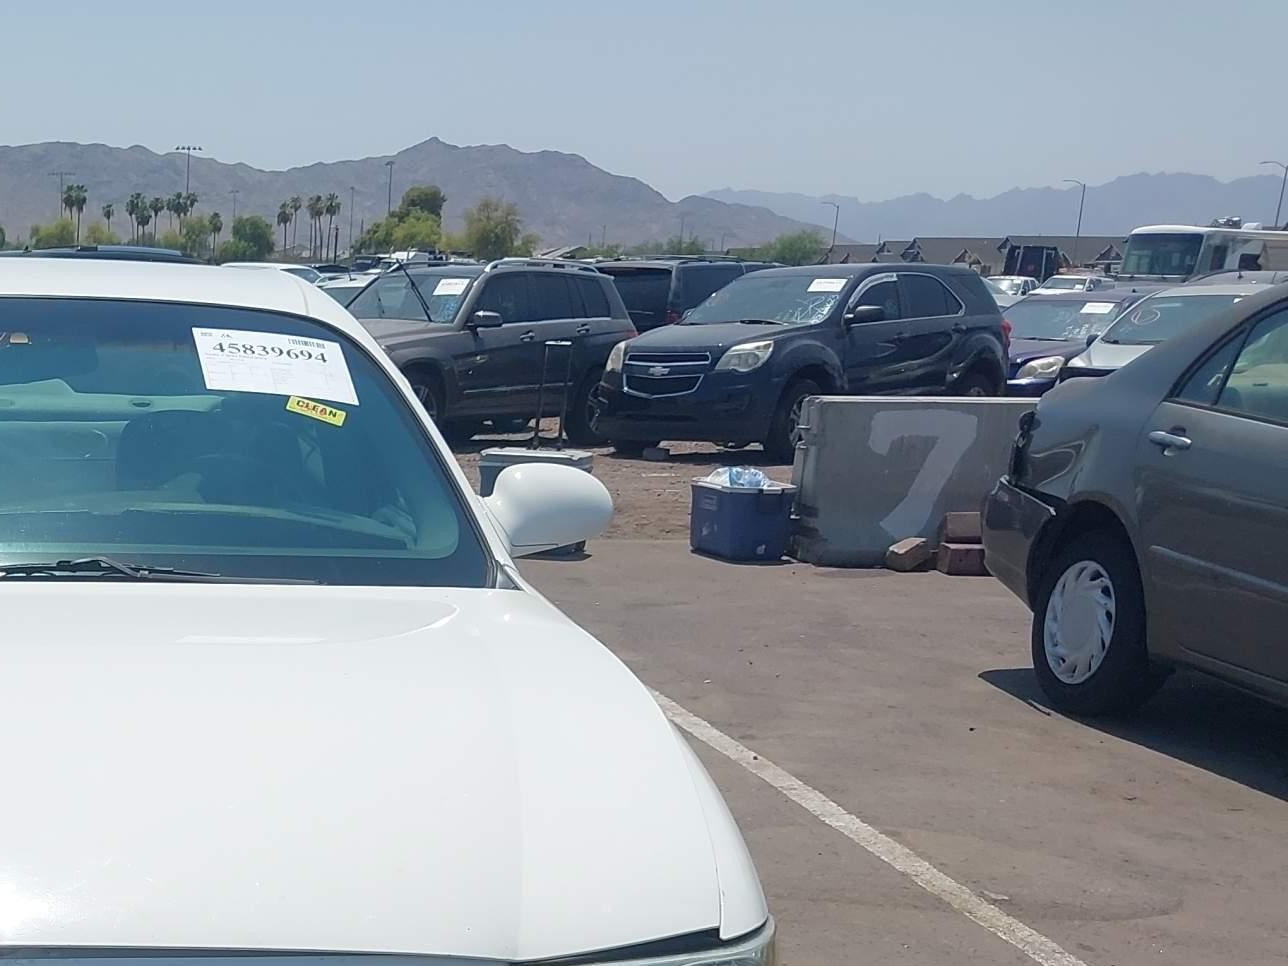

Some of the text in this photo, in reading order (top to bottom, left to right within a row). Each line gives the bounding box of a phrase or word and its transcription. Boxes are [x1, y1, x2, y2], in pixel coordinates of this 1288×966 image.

[212, 341, 328, 364] 45839694
[296, 399, 338, 418] CLEAN
[868, 409, 978, 540] 7
